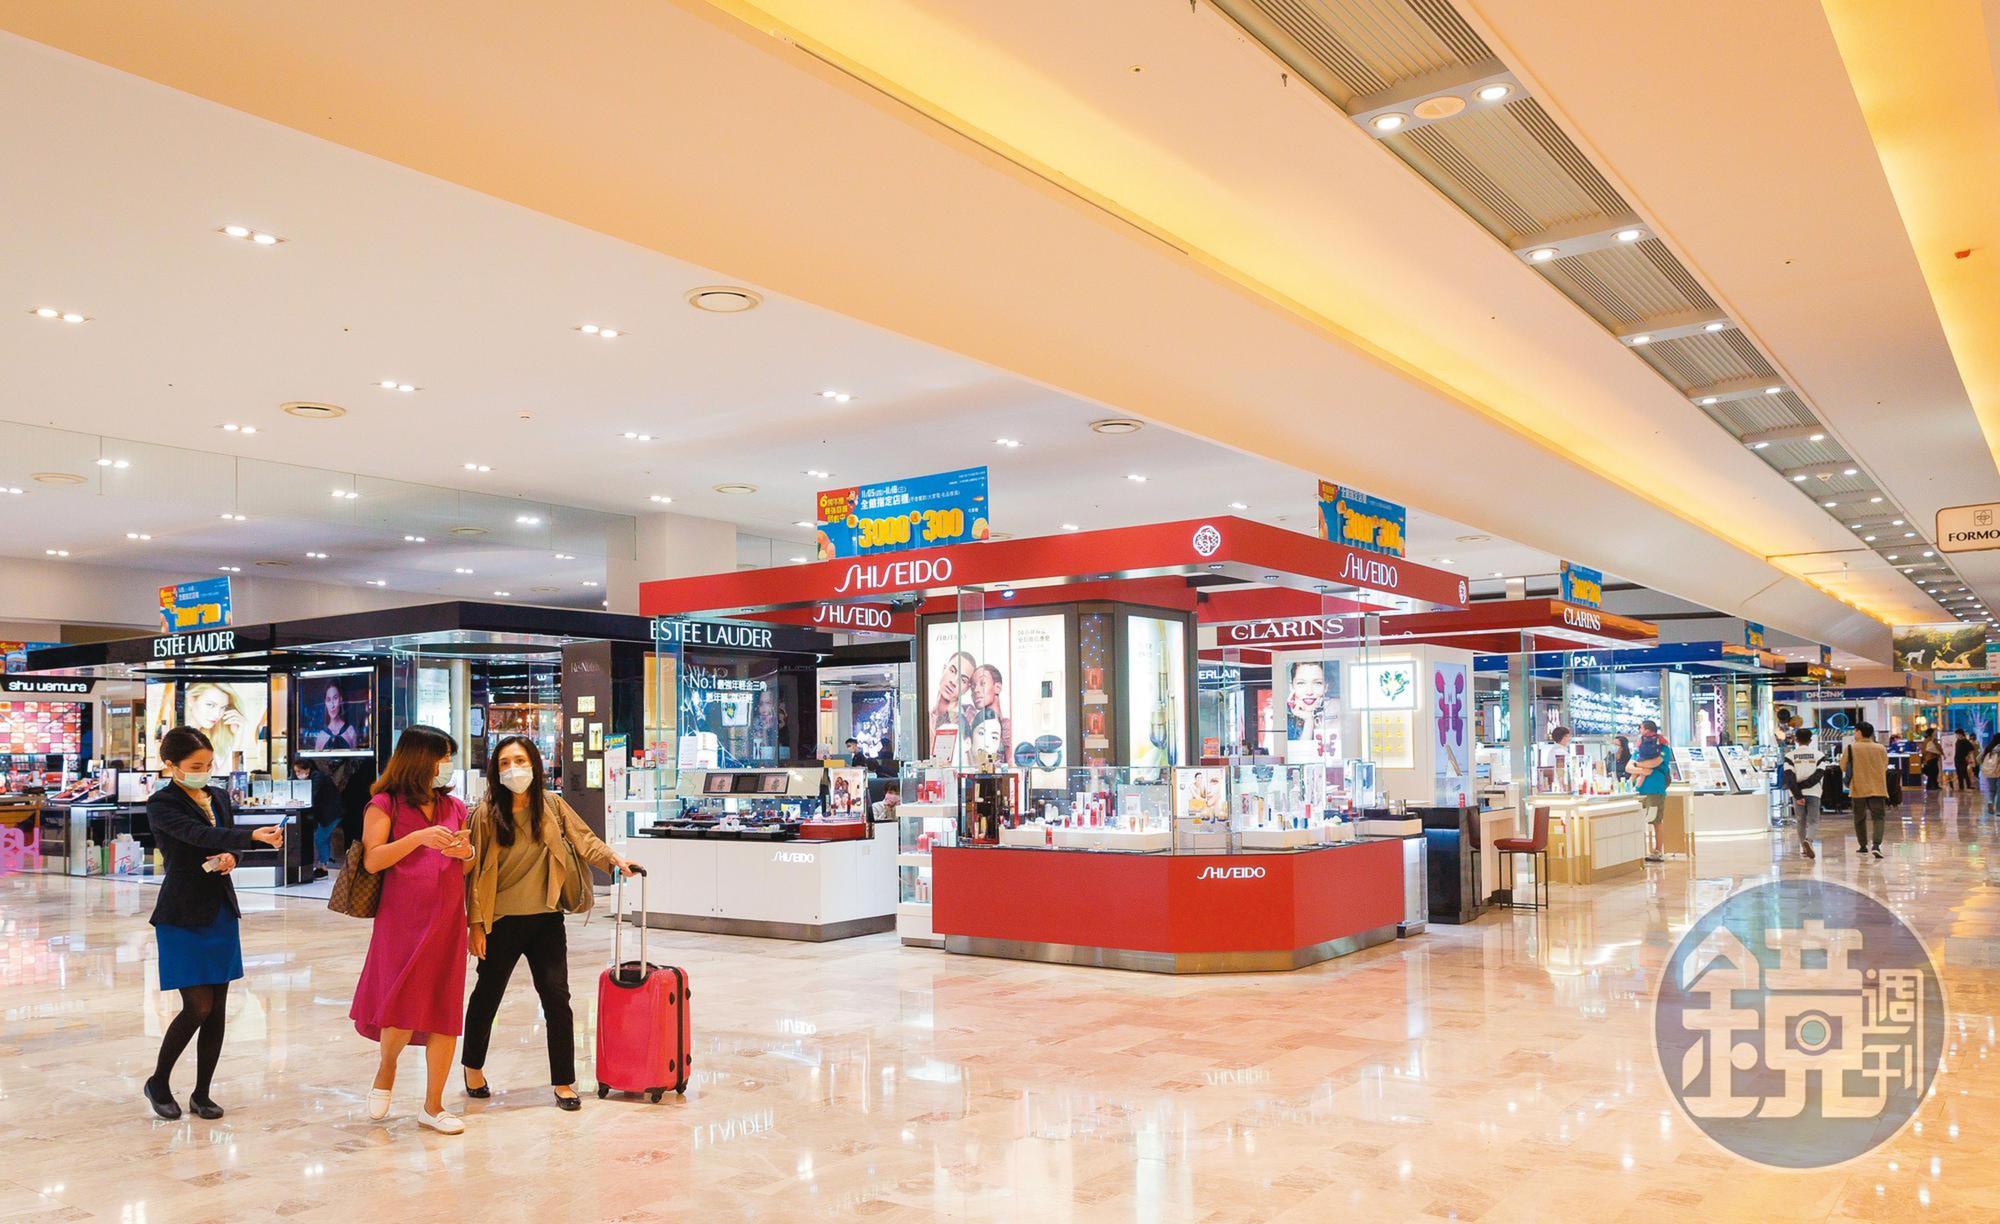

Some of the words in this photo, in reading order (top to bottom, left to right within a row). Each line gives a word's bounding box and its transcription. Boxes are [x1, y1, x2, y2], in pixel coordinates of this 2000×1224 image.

[834, 557, 952, 593] SHISEIDO
[1340, 552, 1398, 588] SHISEIDO
[813, 605, 891, 628] SHISEIDO
[1563, 607, 1601, 631] CLARINS
[706, 625, 773, 649] LAUDER
[1231, 618, 1345, 641] CLARINS
[188, 631, 235, 654] LAUDER
[8, 681, 34, 691] shu
[37, 683, 87, 692] uemura
[770, 850, 815, 863] SHISEIDO
[1196, 866, 1266, 880] SHISEIDO
